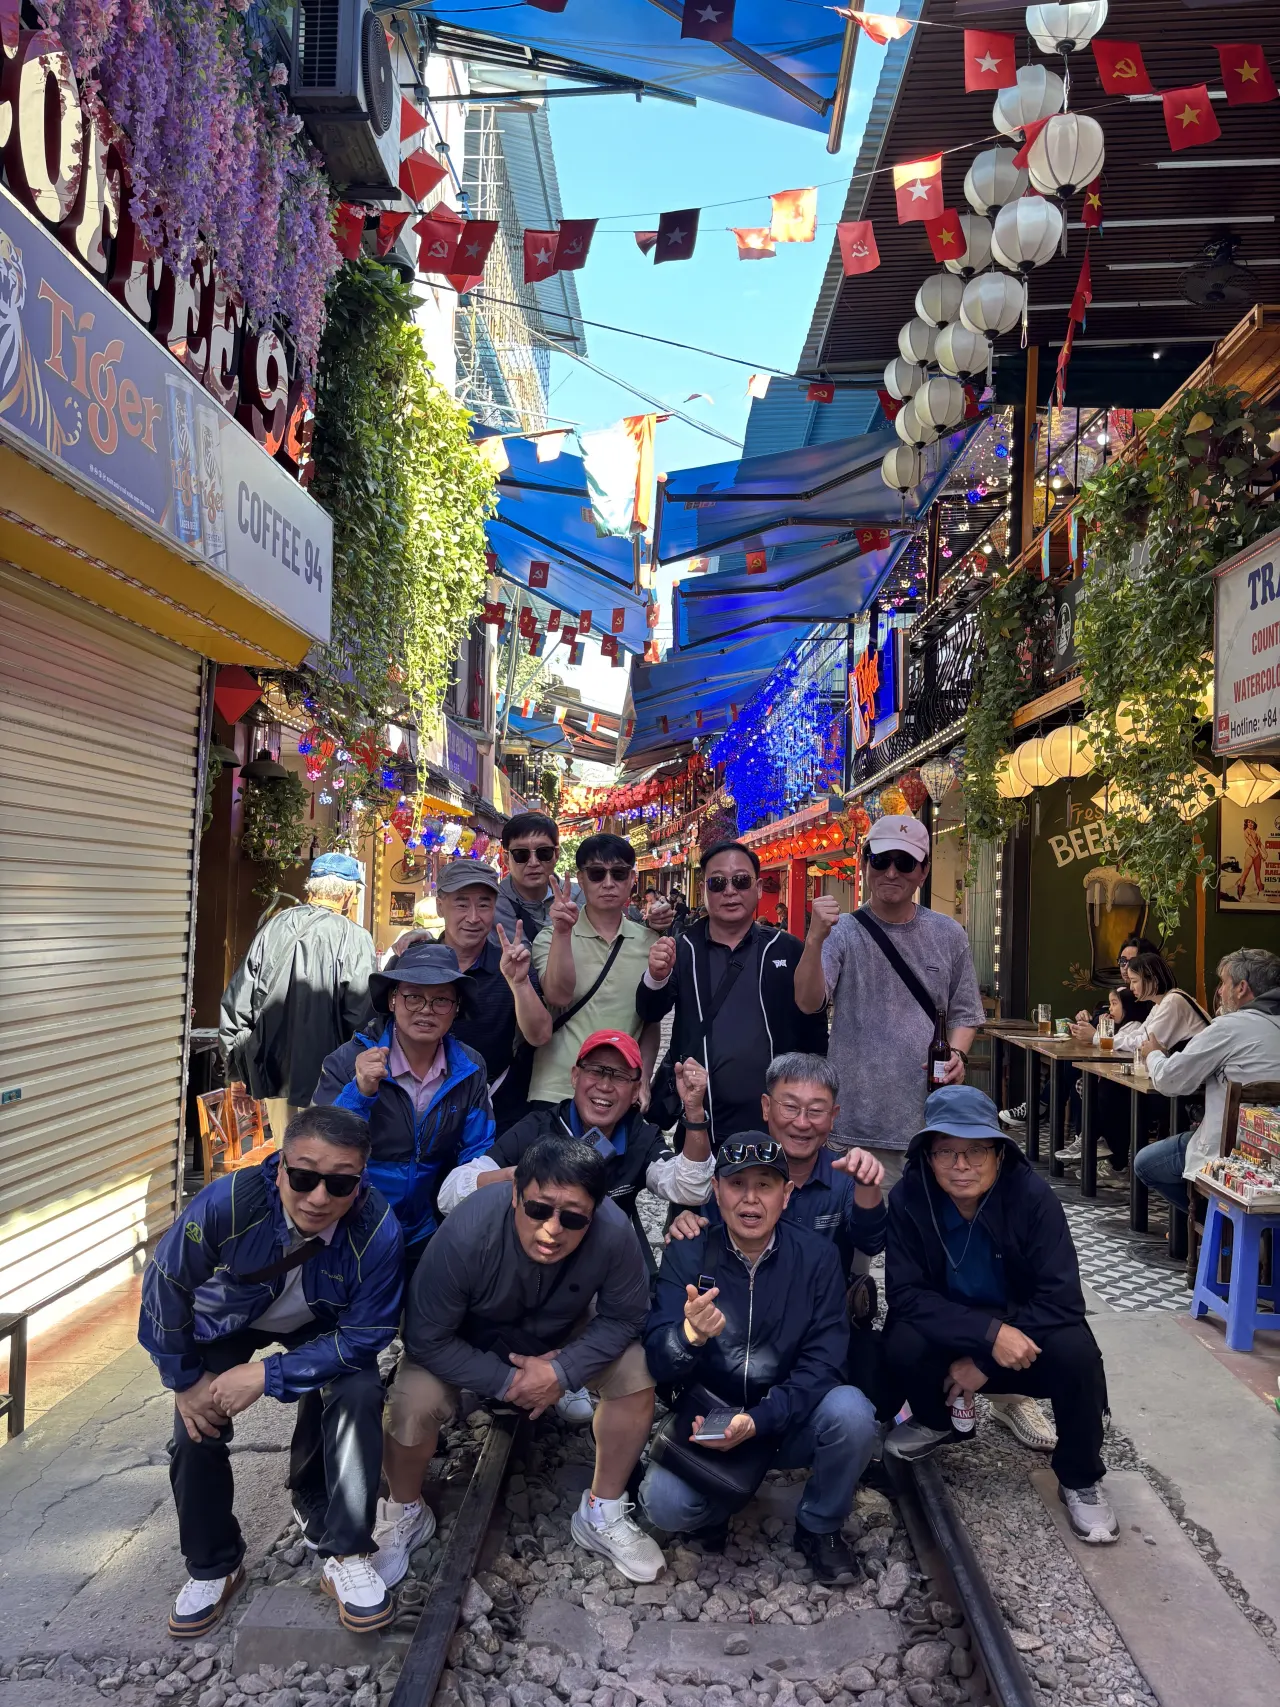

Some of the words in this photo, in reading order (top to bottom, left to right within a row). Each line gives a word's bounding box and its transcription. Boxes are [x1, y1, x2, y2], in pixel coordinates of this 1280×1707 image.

[38, 277, 163, 455] Tiger
[238, 480, 301, 577] COFFEE
[304, 538, 322, 593] 94
[1231, 717, 1260, 739] Hotline:
[1263, 706, 1277, 728] +84
[899, 824, 909, 834] K
[1069, 803, 1105, 825] Fres
